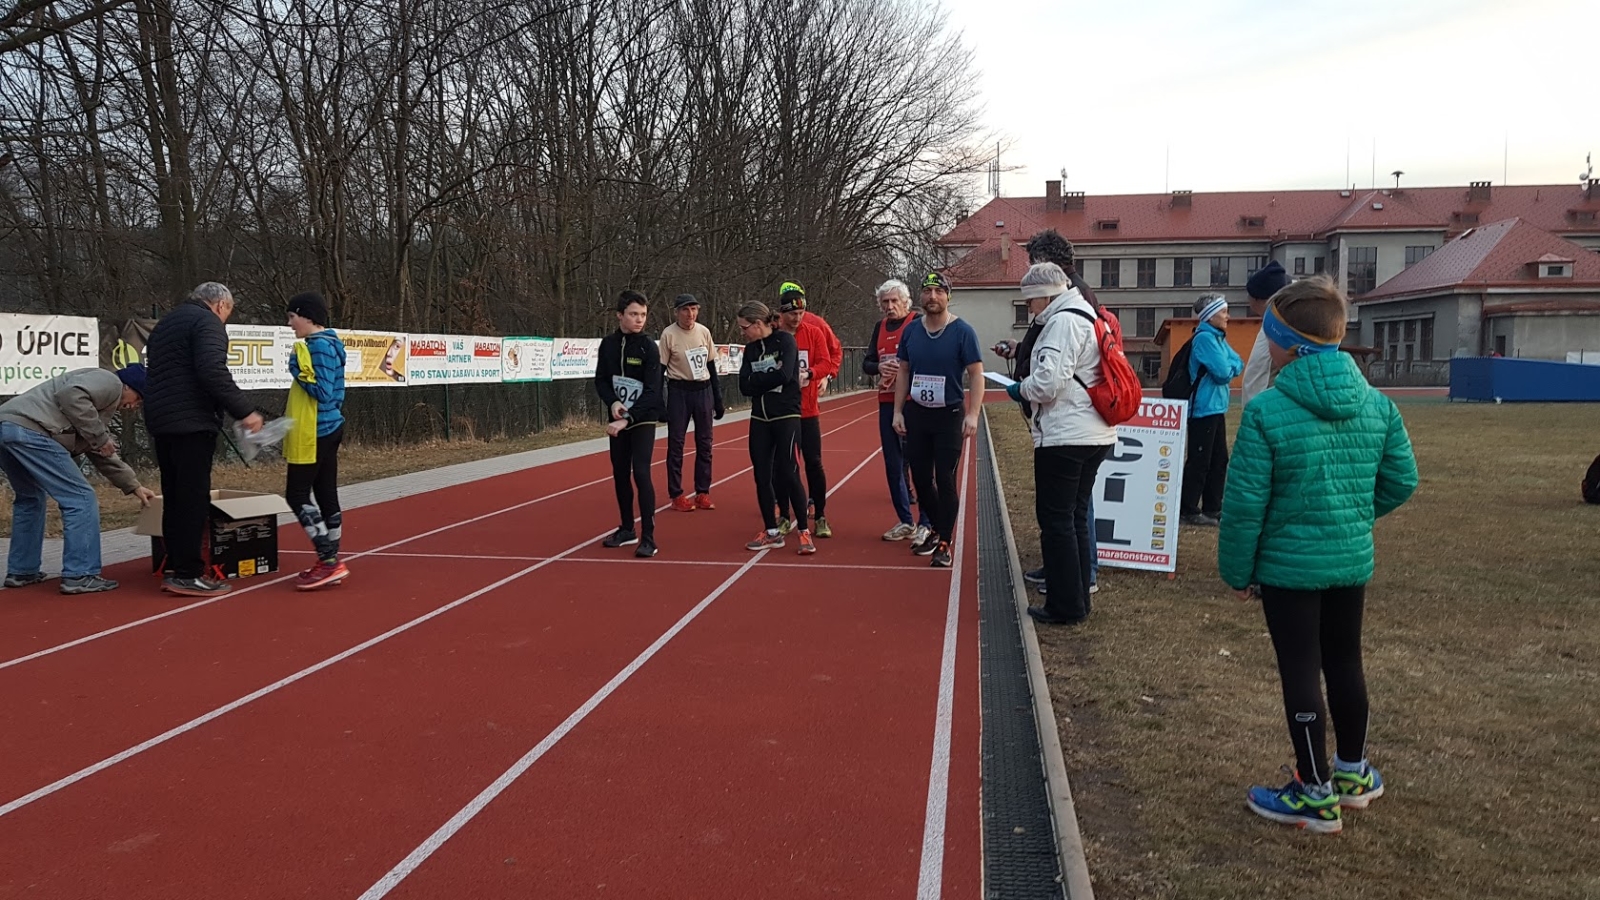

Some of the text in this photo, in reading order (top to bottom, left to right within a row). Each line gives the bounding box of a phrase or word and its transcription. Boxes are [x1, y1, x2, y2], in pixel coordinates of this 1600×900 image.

[16, 325, 90, 356] ÚPICE
[410, 340, 446, 350] MARATON
[452, 339, 464, 350] VÁŠ
[474, 342, 500, 351] MARATON
[226, 339, 274, 366] STC
[447, 355, 471, 363] ARTNER
[690, 353, 707, 369] 197
[230, 367, 260, 375] ESTŘEBÍCH
[410, 370, 425, 379] PRO
[481, 369, 500, 378] SPORT
[614, 386, 639, 403] 194
[920, 389, 935, 402] 83
[1139, 403, 1182, 419] TON
[1152, 419, 1178, 428] stav
